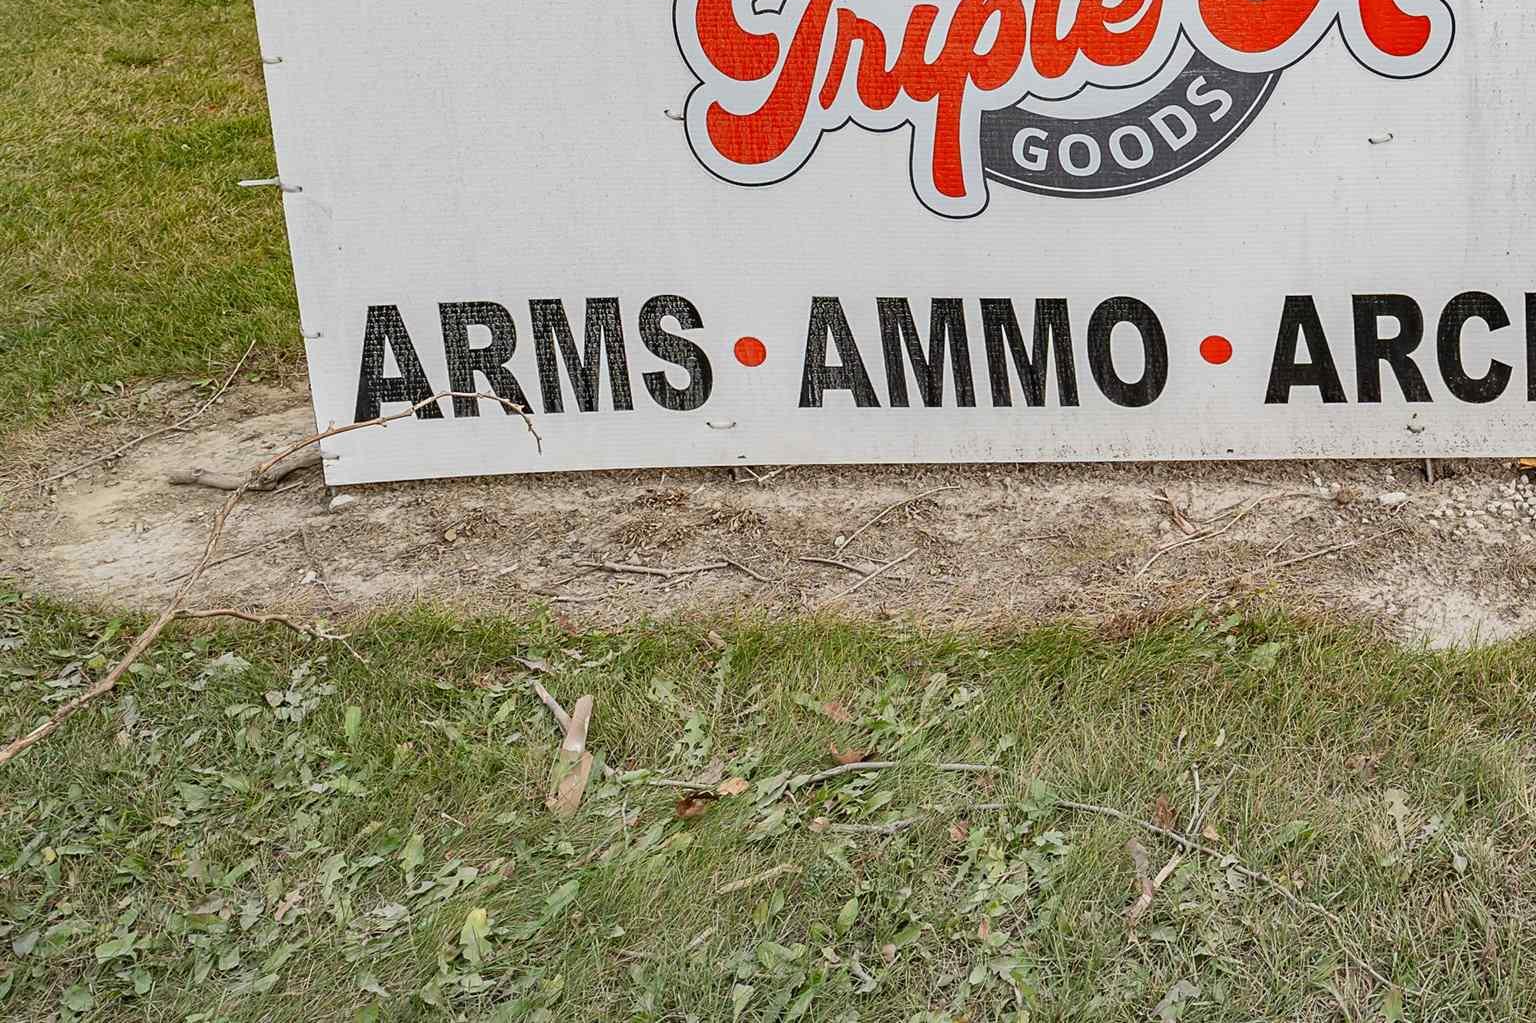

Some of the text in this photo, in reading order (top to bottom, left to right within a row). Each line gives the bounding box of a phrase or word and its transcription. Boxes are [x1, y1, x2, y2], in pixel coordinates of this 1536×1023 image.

[1011, 74, 1235, 178] GOODS
[353, 294, 714, 424] ARMS
[798, 295, 1169, 409] AMMO
